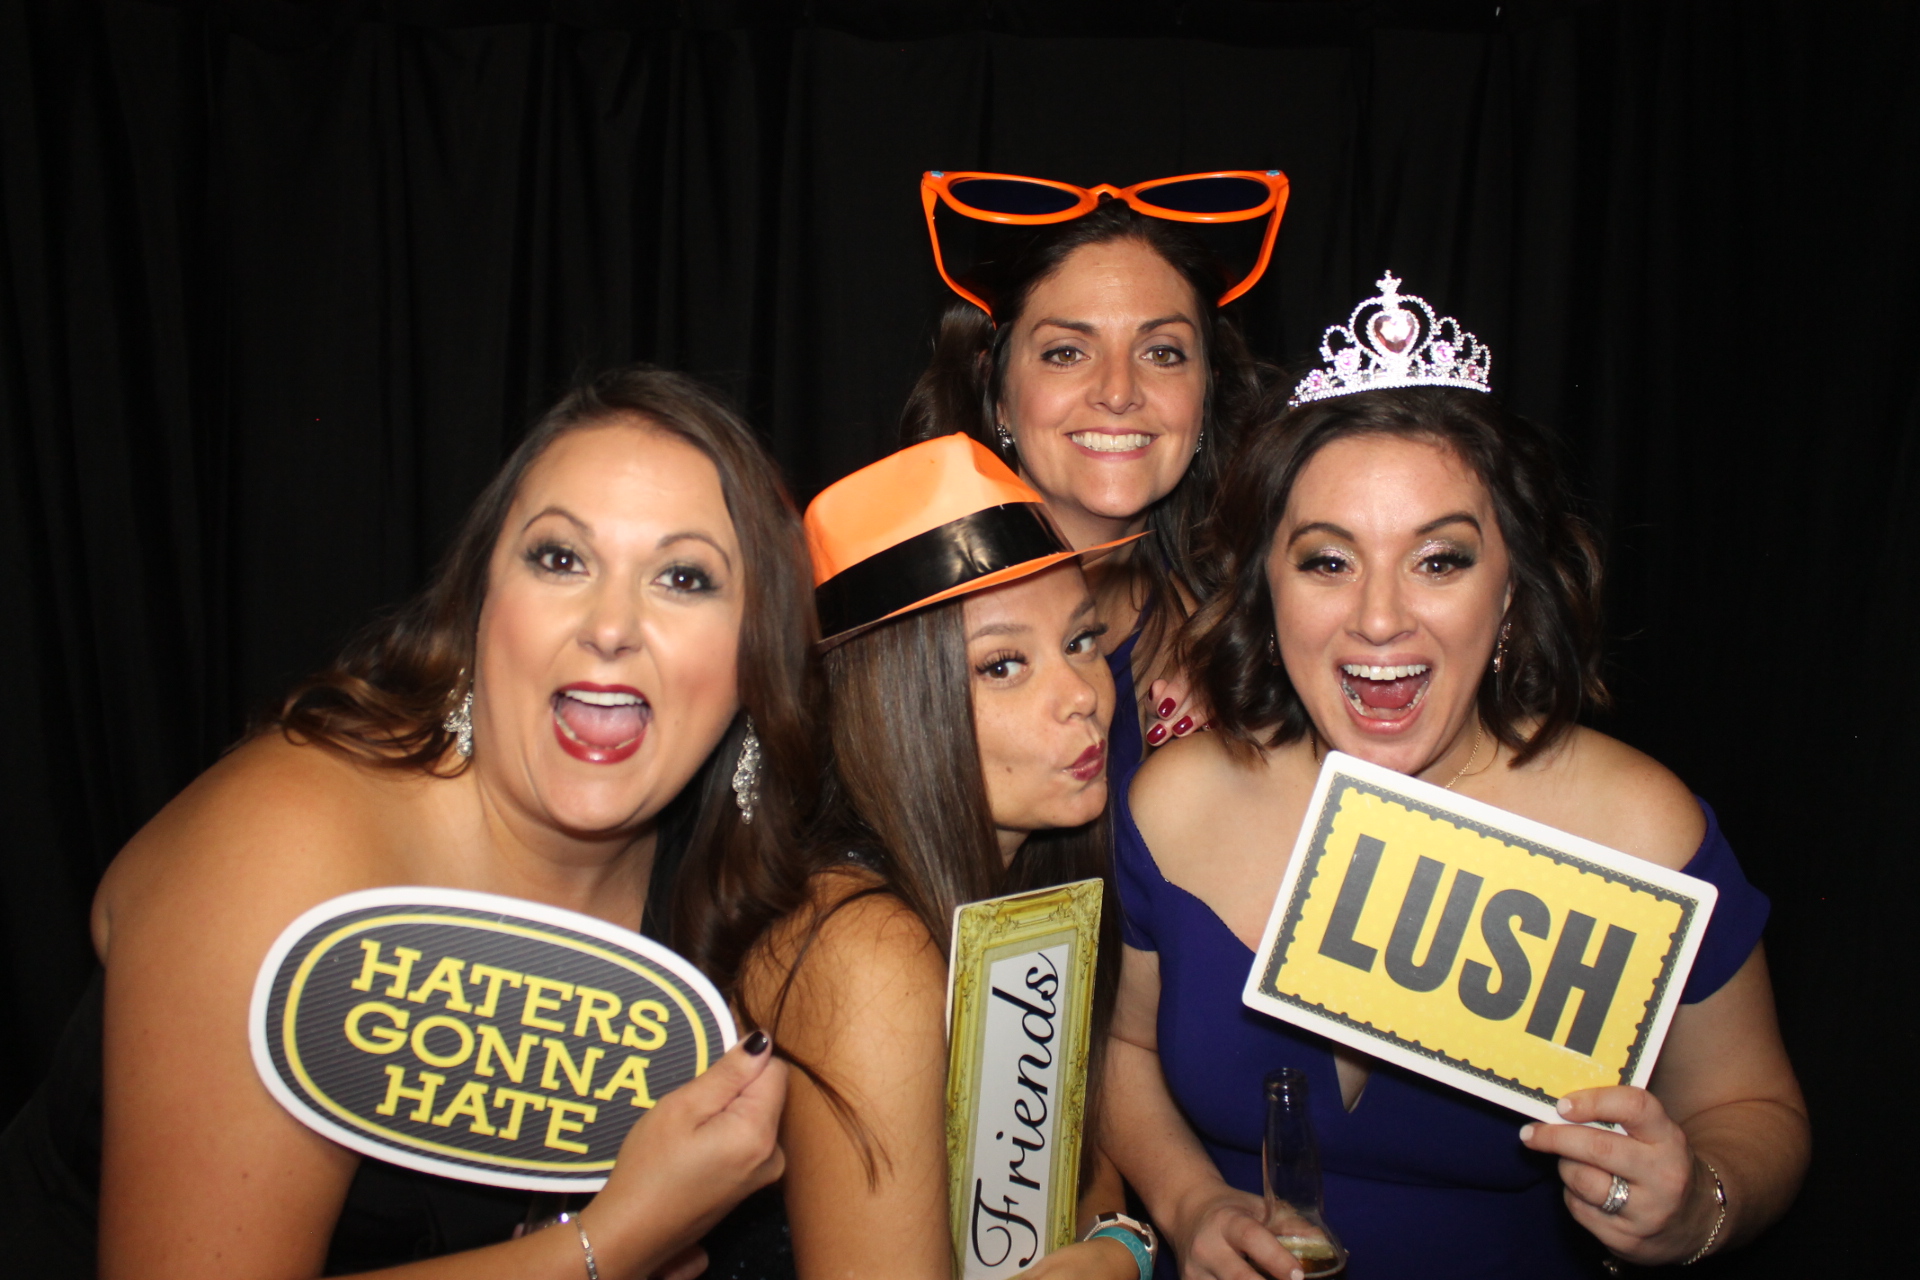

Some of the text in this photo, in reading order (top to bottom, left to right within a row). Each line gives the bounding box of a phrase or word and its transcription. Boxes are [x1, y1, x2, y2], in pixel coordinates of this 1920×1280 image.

[351, 938, 669, 1051] HATERS
[1318, 833, 1637, 1057] LUSH
[344, 1001, 656, 1109] GONNA
[375, 1065, 598, 1154] HATE
[972, 952, 1059, 1268] Friends
